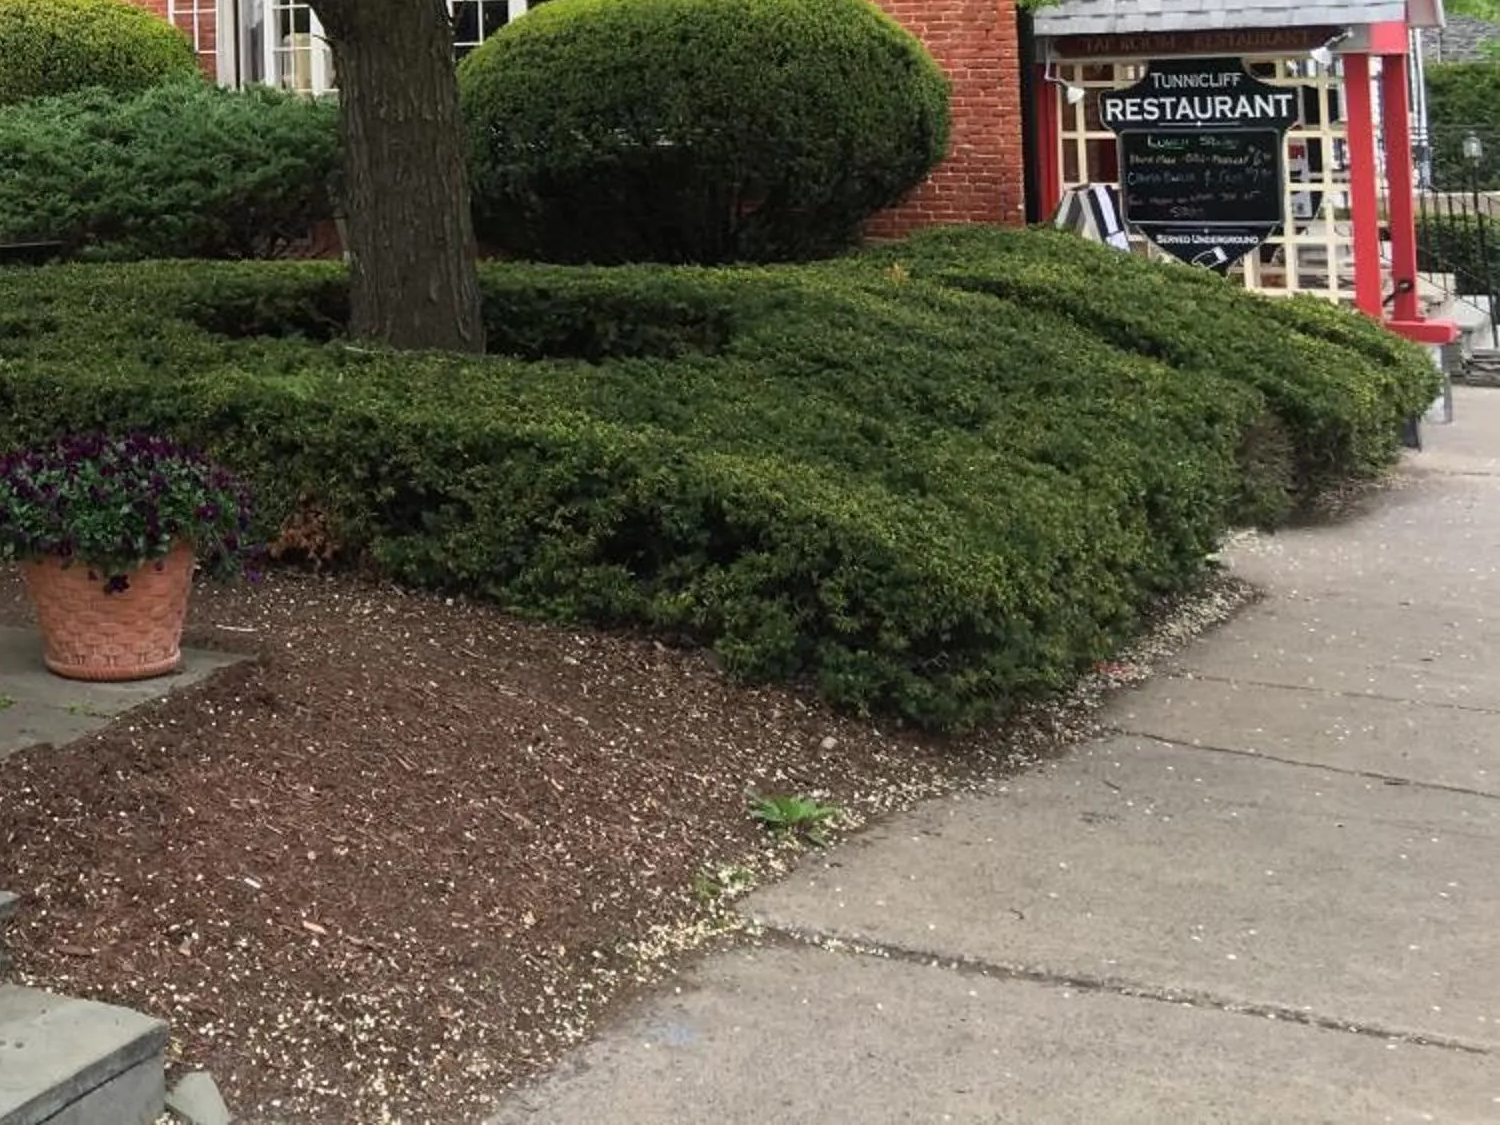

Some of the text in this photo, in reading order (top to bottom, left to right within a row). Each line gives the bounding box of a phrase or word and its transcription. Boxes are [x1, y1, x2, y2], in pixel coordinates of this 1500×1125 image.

[1151, 72, 1242, 89] TUNNICLIFF
[1105, 94, 1293, 122] RESTAURANT
[1155, 234, 1259, 245] SERVED UNDERGROUND
